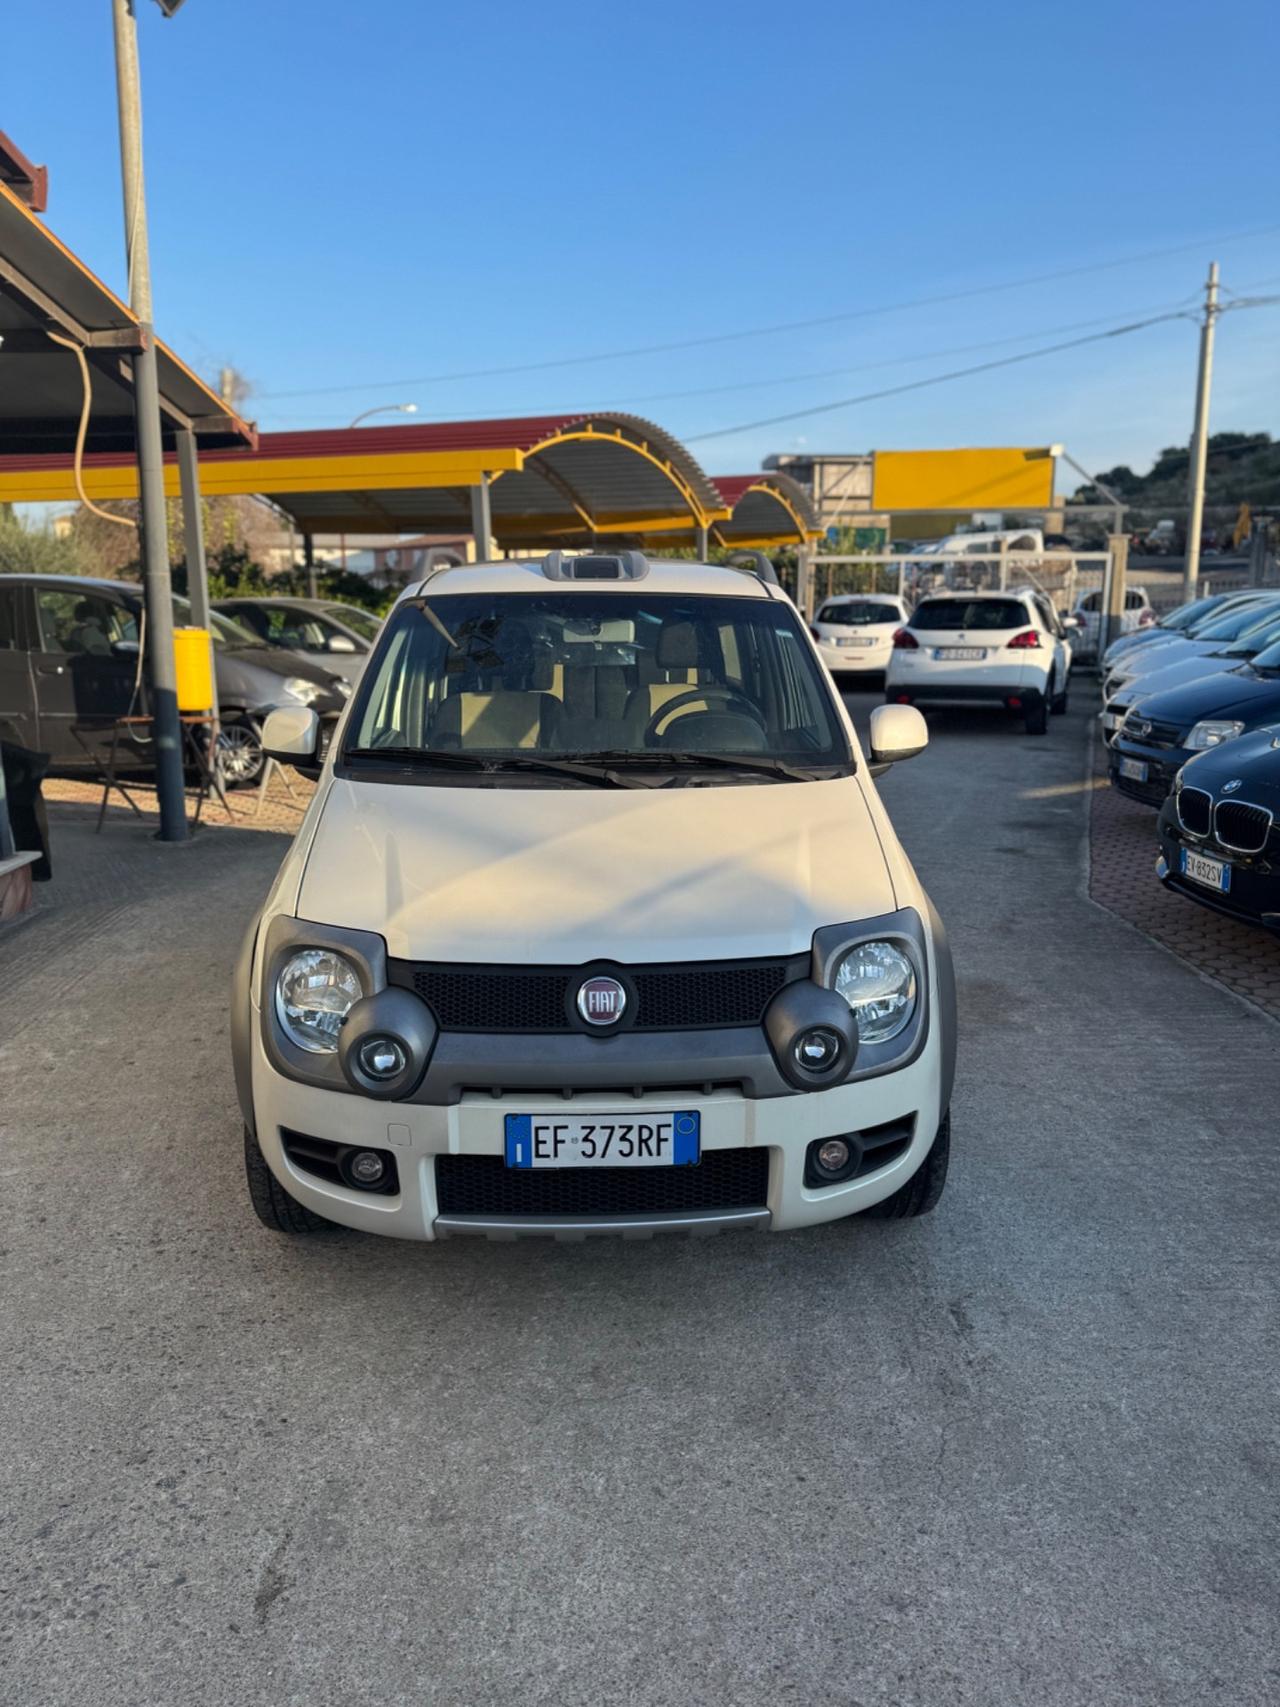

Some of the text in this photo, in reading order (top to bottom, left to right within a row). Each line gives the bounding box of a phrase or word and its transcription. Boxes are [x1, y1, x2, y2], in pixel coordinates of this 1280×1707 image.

[588, 990, 617, 1013] FIAT
[534, 1125, 569, 1159] EF
[580, 1123, 672, 1159] 373RF
